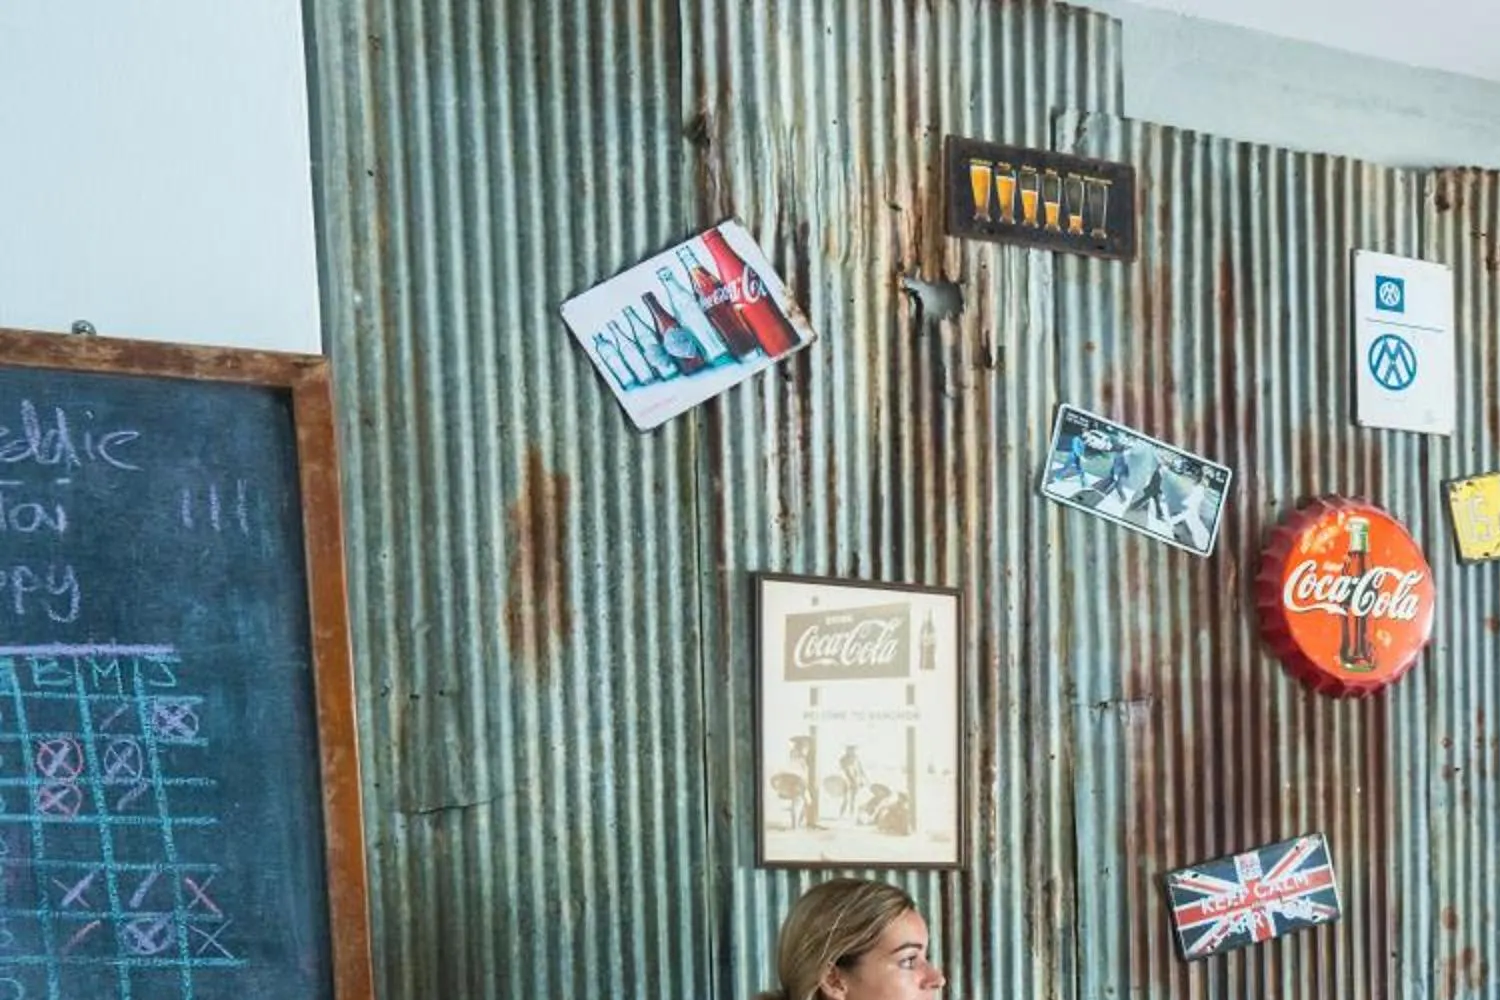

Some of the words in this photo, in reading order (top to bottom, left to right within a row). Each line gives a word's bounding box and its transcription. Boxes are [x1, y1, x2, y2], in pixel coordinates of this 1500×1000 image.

[1283, 559, 1424, 621] Coca-Cola
[794, 617, 904, 668] Coca-Cola
[1201, 884, 1250, 915] KEEP
[1253, 873, 1310, 899] CALM
